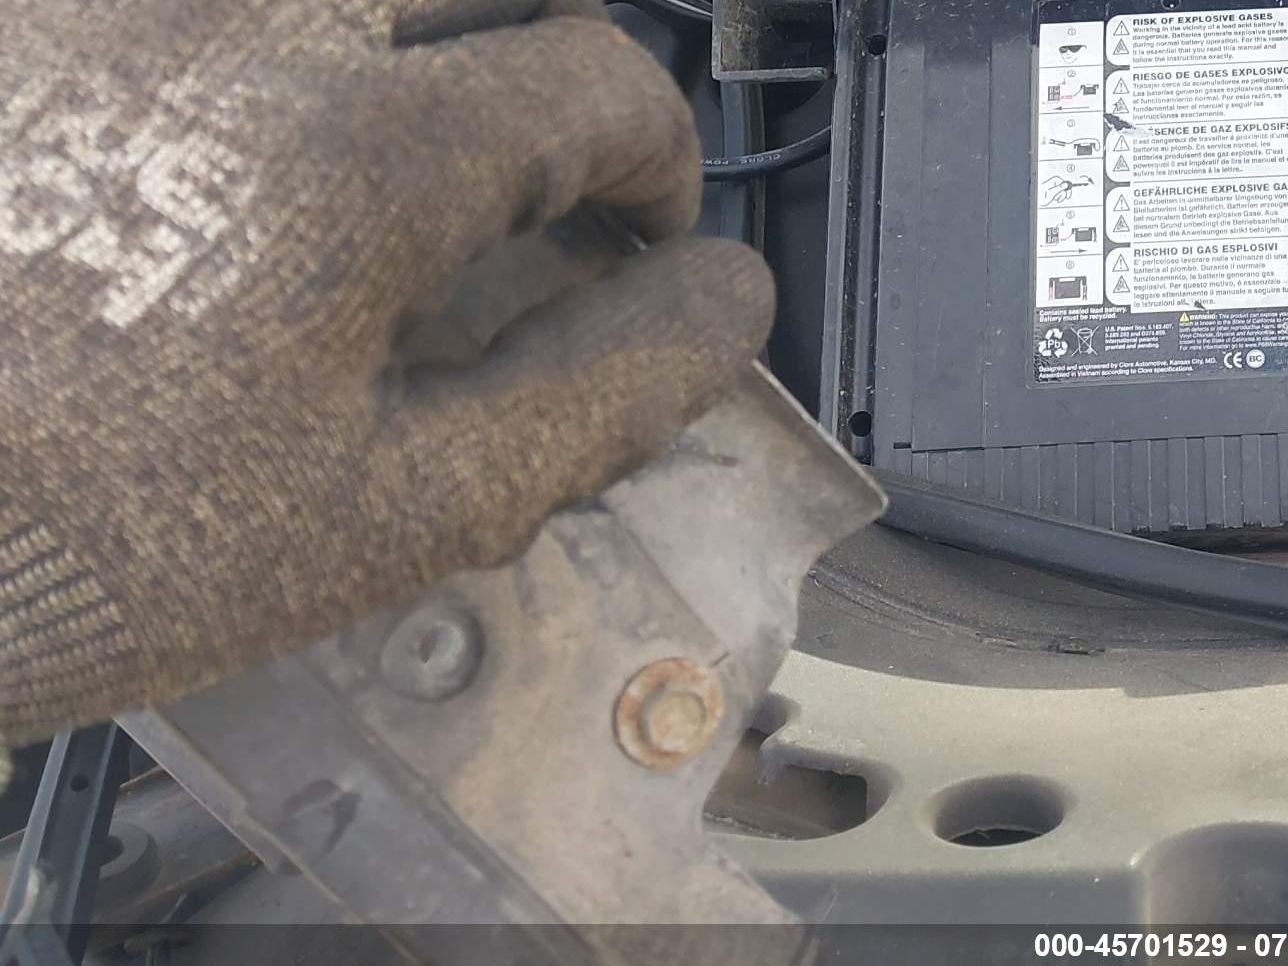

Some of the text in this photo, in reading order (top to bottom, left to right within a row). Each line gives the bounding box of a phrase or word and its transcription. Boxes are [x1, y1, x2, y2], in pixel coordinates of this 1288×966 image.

[1132, 17, 1157, 26] RISK
[1177, 14, 1234, 24] EXPLOSIVE
[1238, 12, 1273, 21] GASES
[1132, 71, 1171, 81] RIESGO
[1175, 71, 1189, 79] DE
[1193, 69, 1228, 78] GASES
[1192, 125, 1206, 134] DE
[1210, 124, 1231, 133] GAZ
[1133, 185, 1207, 197] GEFÄHRLICHE
[1211, 183, 1269, 193] EXPLOSIVE
[1133, 242, 1277, 257] RISCHIO DI GAS ESPLOSIVI
[1039, 315, 1062, 323] Battery
[1048, 339, 1060, 349] Pb
[1224, 352, 1242, 368] CE
[1249, 355, 1262, 363] BC
